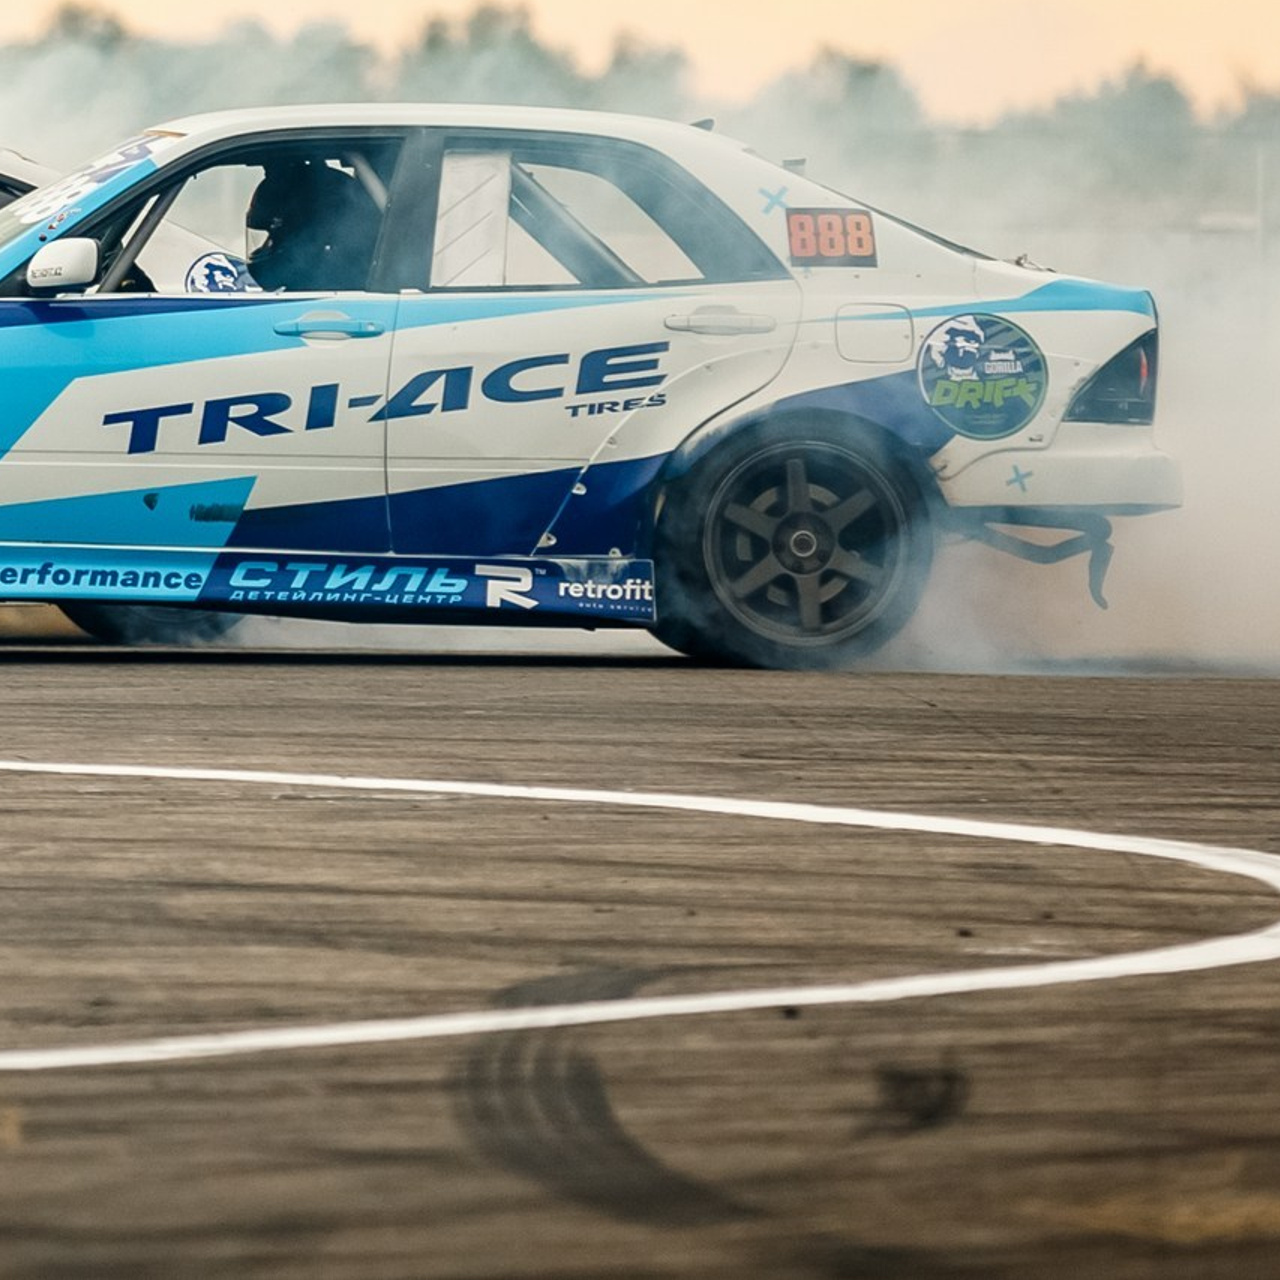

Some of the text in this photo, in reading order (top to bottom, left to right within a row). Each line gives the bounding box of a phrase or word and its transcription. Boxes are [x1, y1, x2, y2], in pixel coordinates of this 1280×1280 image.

[789, 213, 874, 257] 888
[984, 360, 1024, 374] GORILLA
[103, 341, 670, 455] TRI-ACE
[565, 393, 666, 418] TIRES
[228, 561, 469, 594] СТИЛЬ
[558, 578, 654, 601] retrofit
[228, 590, 463, 605] ДЕТЕЙЛИНГ-ЦЕНТР
